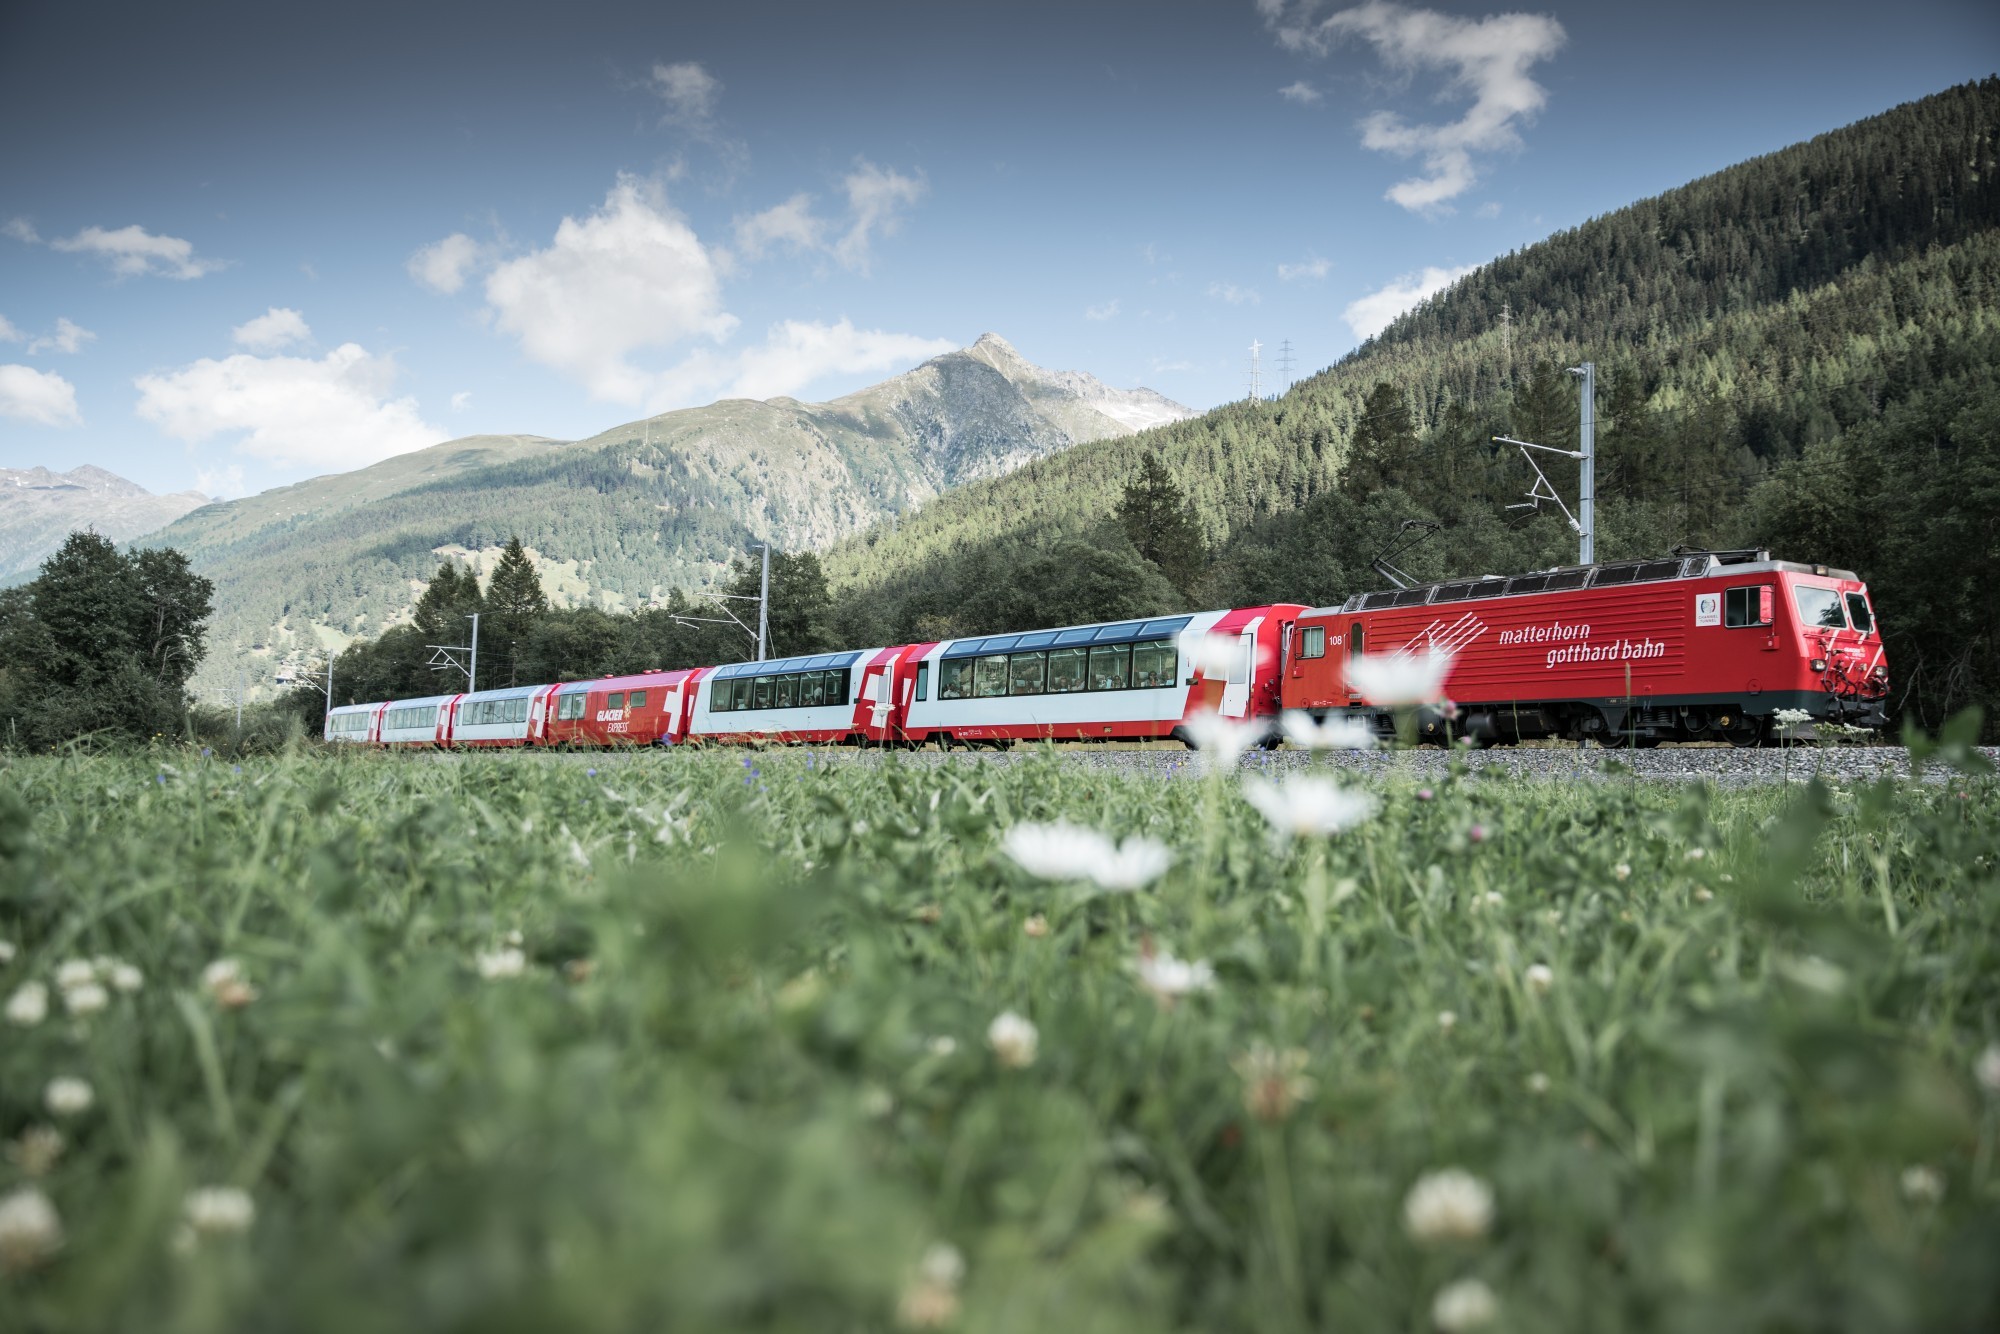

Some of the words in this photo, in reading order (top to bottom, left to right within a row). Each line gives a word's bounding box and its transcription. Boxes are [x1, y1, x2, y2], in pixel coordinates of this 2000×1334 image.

[1499, 622, 1590, 644] matterhorn
[1329, 635, 1342, 645] 108
[1546, 640, 1620, 669] gotthard
[1621, 638, 1665, 659] bahn
[597, 709, 623, 721] GLACIER
[608, 722, 629, 732] EXPRESS
